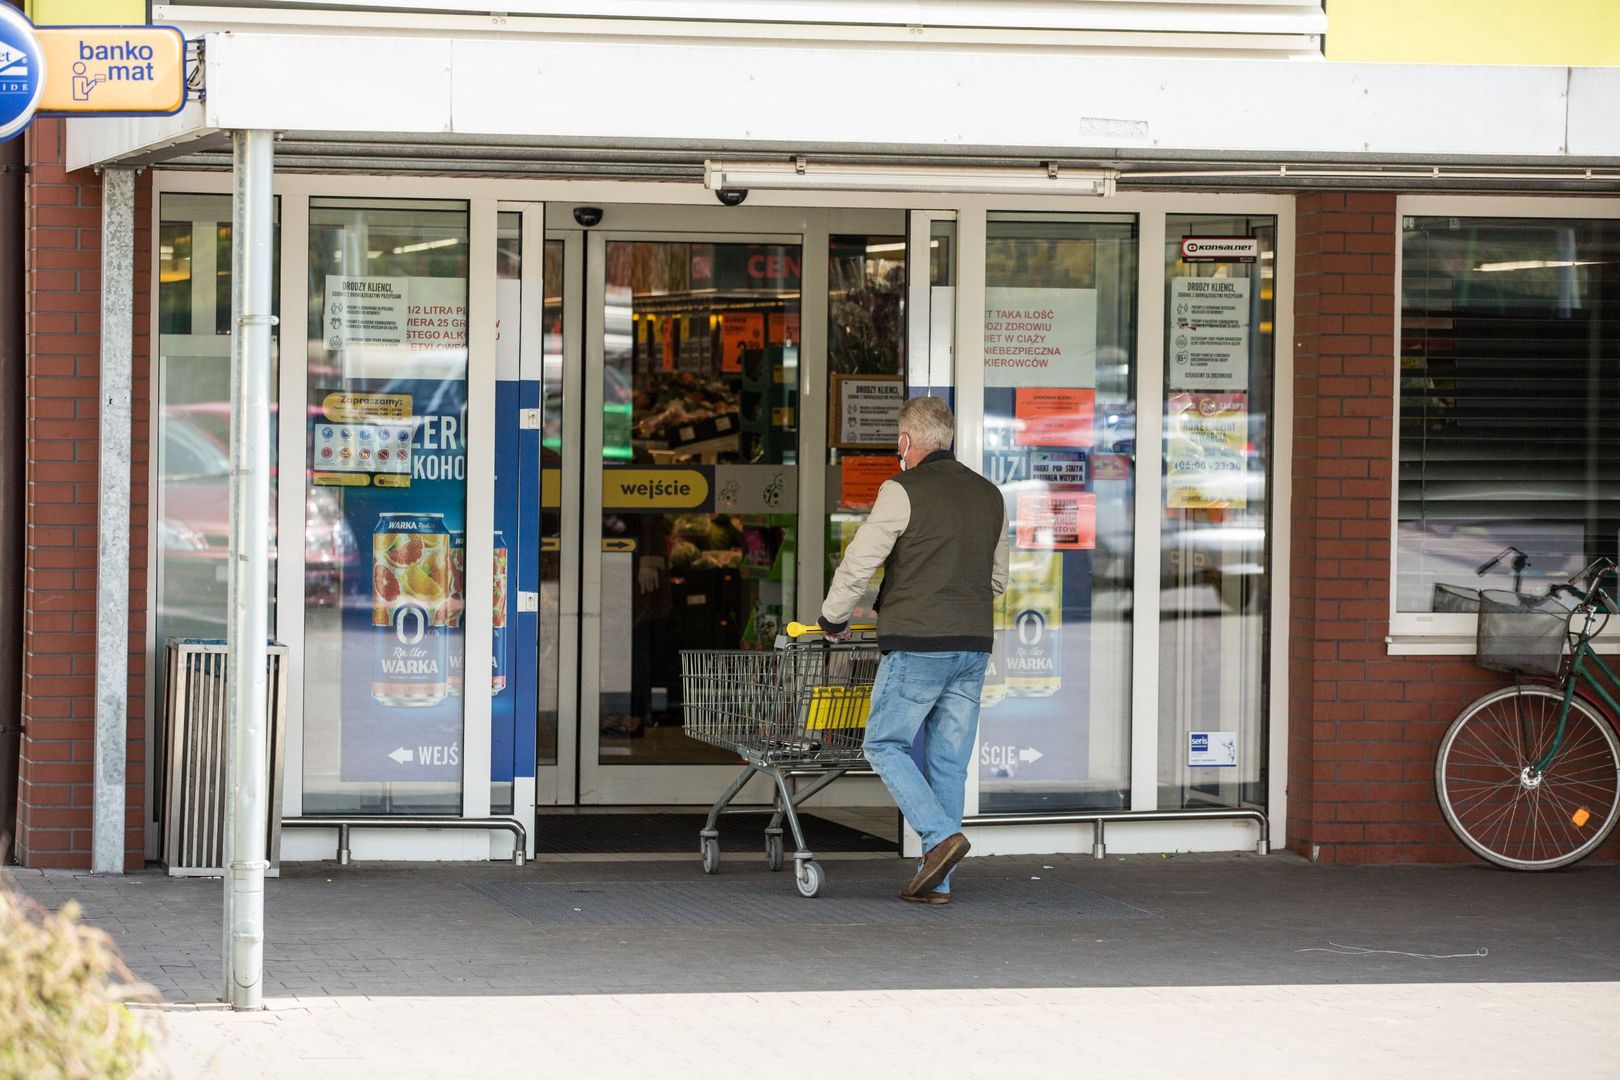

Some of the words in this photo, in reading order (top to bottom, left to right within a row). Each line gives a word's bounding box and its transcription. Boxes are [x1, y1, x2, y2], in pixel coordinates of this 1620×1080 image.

[79, 41, 153, 60] banko
[108, 63, 153, 81] mat
[342, 281, 366, 292] DRODZY
[367, 282, 393, 294] KLIENCI,
[1187, 282, 1210, 292] DRODZY
[407, 306, 420, 314] 1/2
[424, 306, 453, 315] LITRA
[997, 311, 1021, 319] TAKA
[1024, 309, 1054, 320] ILOŚĆ
[437, 319, 449, 328] 25
[985, 322, 1002, 331] DZI
[1005, 322, 1052, 332] ZDROWIU
[443, 332, 465, 340] ALK
[985, 335, 1001, 343] IET
[1005, 335, 1014, 343] W
[1017, 334, 1046, 345] CIĄŻY
[985, 347, 1061, 356] NIEBEZPIECZNA
[985, 358, 1048, 368] KIEROWCÓW
[411, 416, 465, 449] ZER
[410, 455, 465, 481] KOHO
[620, 480, 691, 499] wejście
[388, 521, 417, 530] WARKA
[381, 659, 438, 674] WARKA
[1006, 657, 1053, 670] WARKA
[418, 742, 459, 766] WEJŚ
[980, 742, 1016, 766] ŚCIE
